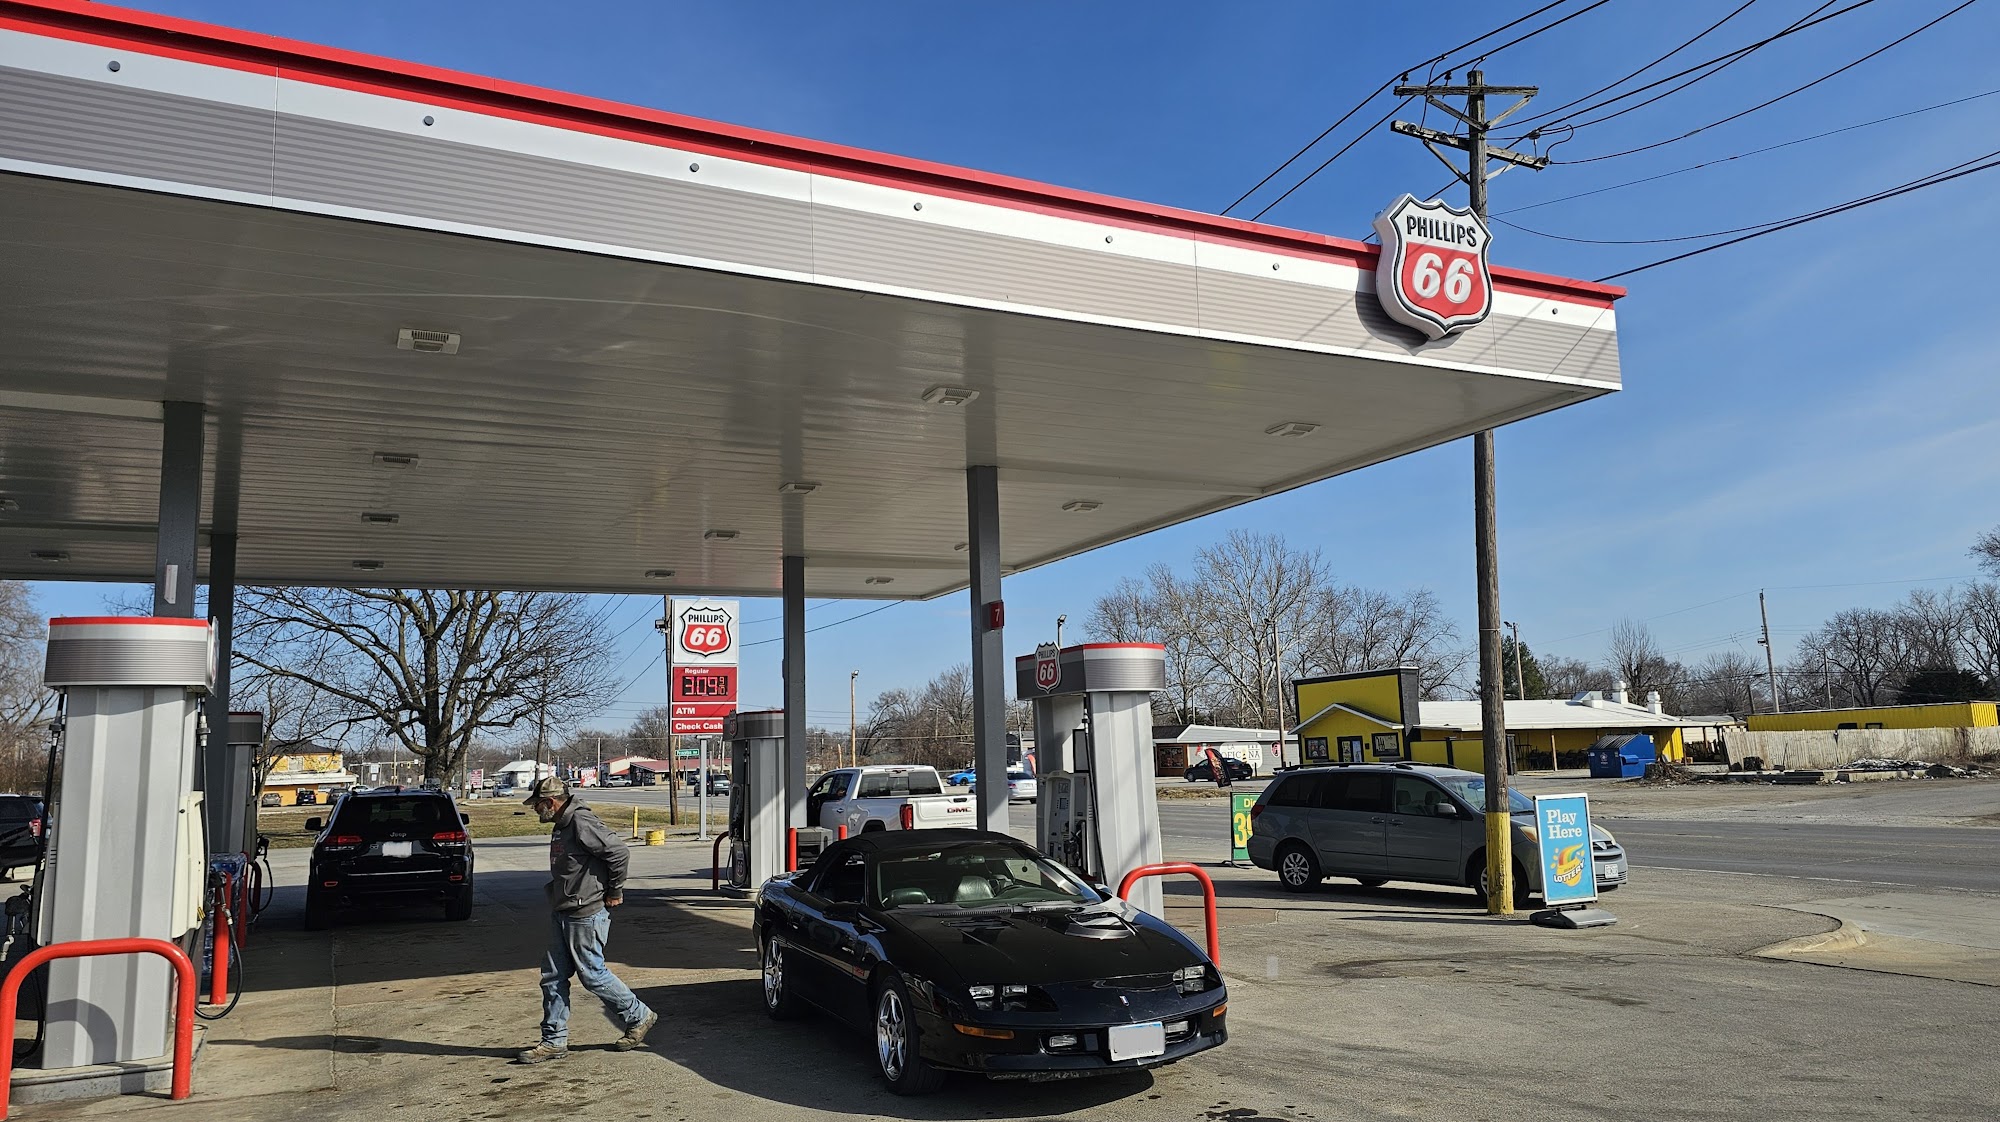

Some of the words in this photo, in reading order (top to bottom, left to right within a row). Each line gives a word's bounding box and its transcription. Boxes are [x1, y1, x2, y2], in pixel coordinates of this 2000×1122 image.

[1406, 214, 1477, 247] PHILLIPS
[1411, 252, 1475, 304] 66
[688, 614, 724, 624] PHILLIPS
[994, 608, 1000, 622] 7
[689, 627, 722, 646] 66
[1038, 648, 1056, 659] PHILLIPS
[684, 667, 710, 675] Regular
[1039, 662, 1055, 682] 66
[675, 707, 696, 715] ATM
[675, 722, 701, 730] Check
[1545, 809, 1577, 826] Play
[1547, 824, 1583, 839] Here
[1553, 858, 1585, 883] LOTTERY
